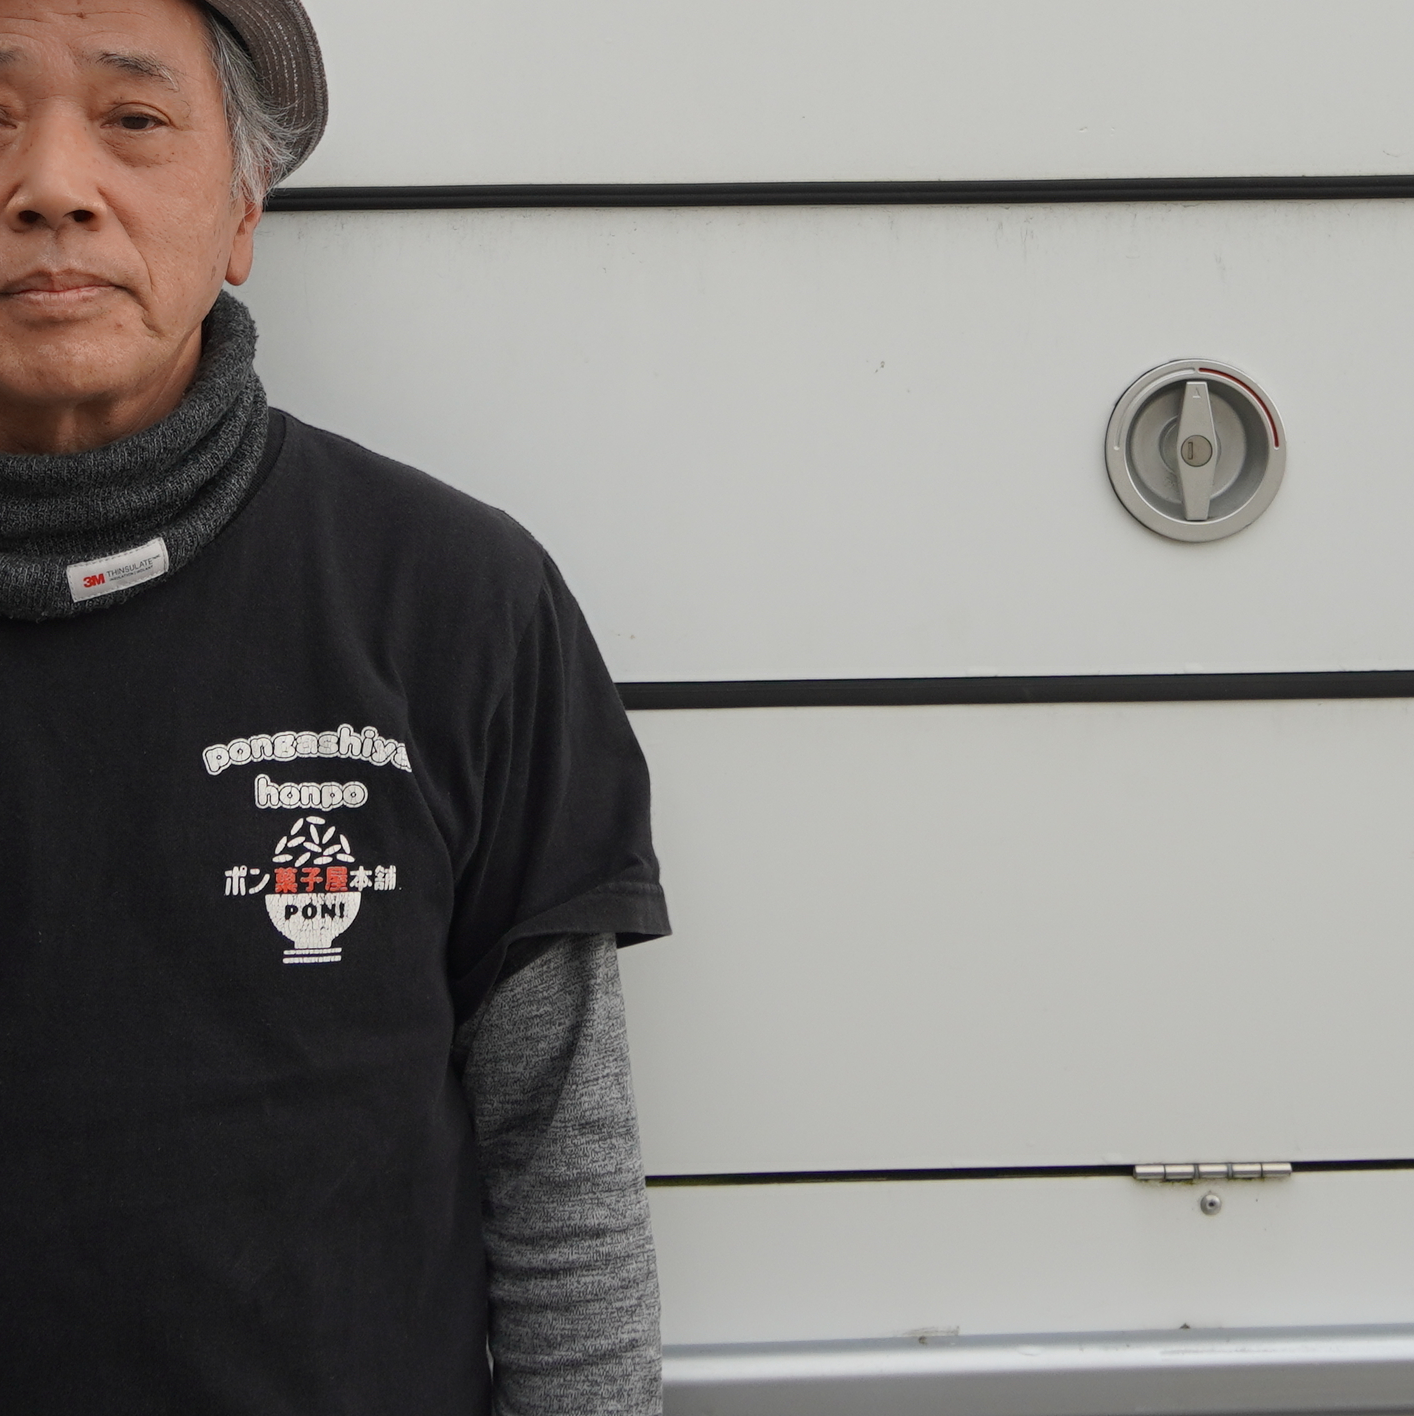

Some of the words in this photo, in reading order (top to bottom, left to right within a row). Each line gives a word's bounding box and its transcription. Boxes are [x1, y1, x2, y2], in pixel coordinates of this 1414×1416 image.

[83, 573, 105, 588] 3M
[254, 773, 368, 811] honpo
[224, 865, 397, 896] ポン菓子屋本舗
[284, 903, 346, 920] PON!
